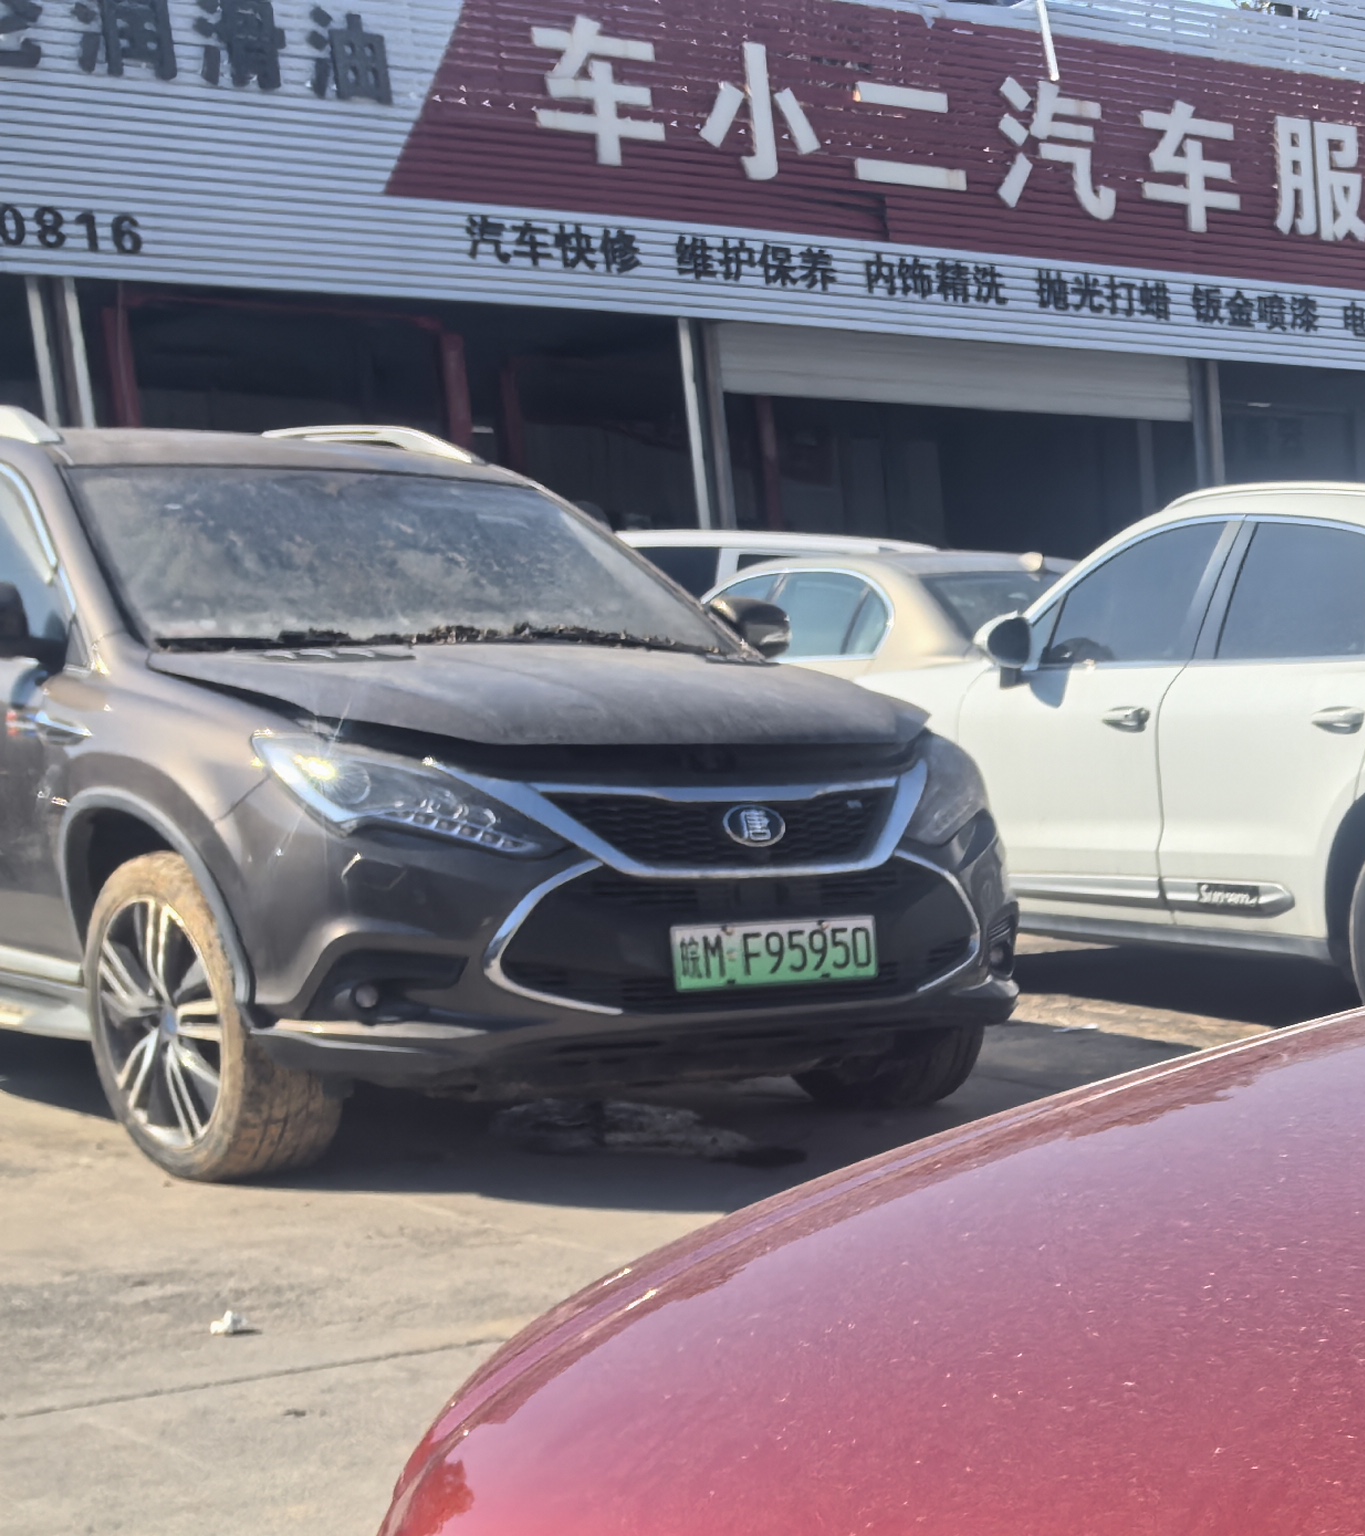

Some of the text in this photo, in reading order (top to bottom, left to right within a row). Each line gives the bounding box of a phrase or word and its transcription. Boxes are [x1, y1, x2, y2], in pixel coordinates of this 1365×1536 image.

[0, 205, 143, 255] 0816
[466, 213, 641, 276] 汽车快修
[675, 233, 838, 293] 维护保养
[865, 252, 1009, 306] 内饰精洗
[1035, 267, 1172, 322] 抛光打蜡
[1192, 282, 1319, 333] 钣金喷漆
[741, 926, 873, 977] F95950
